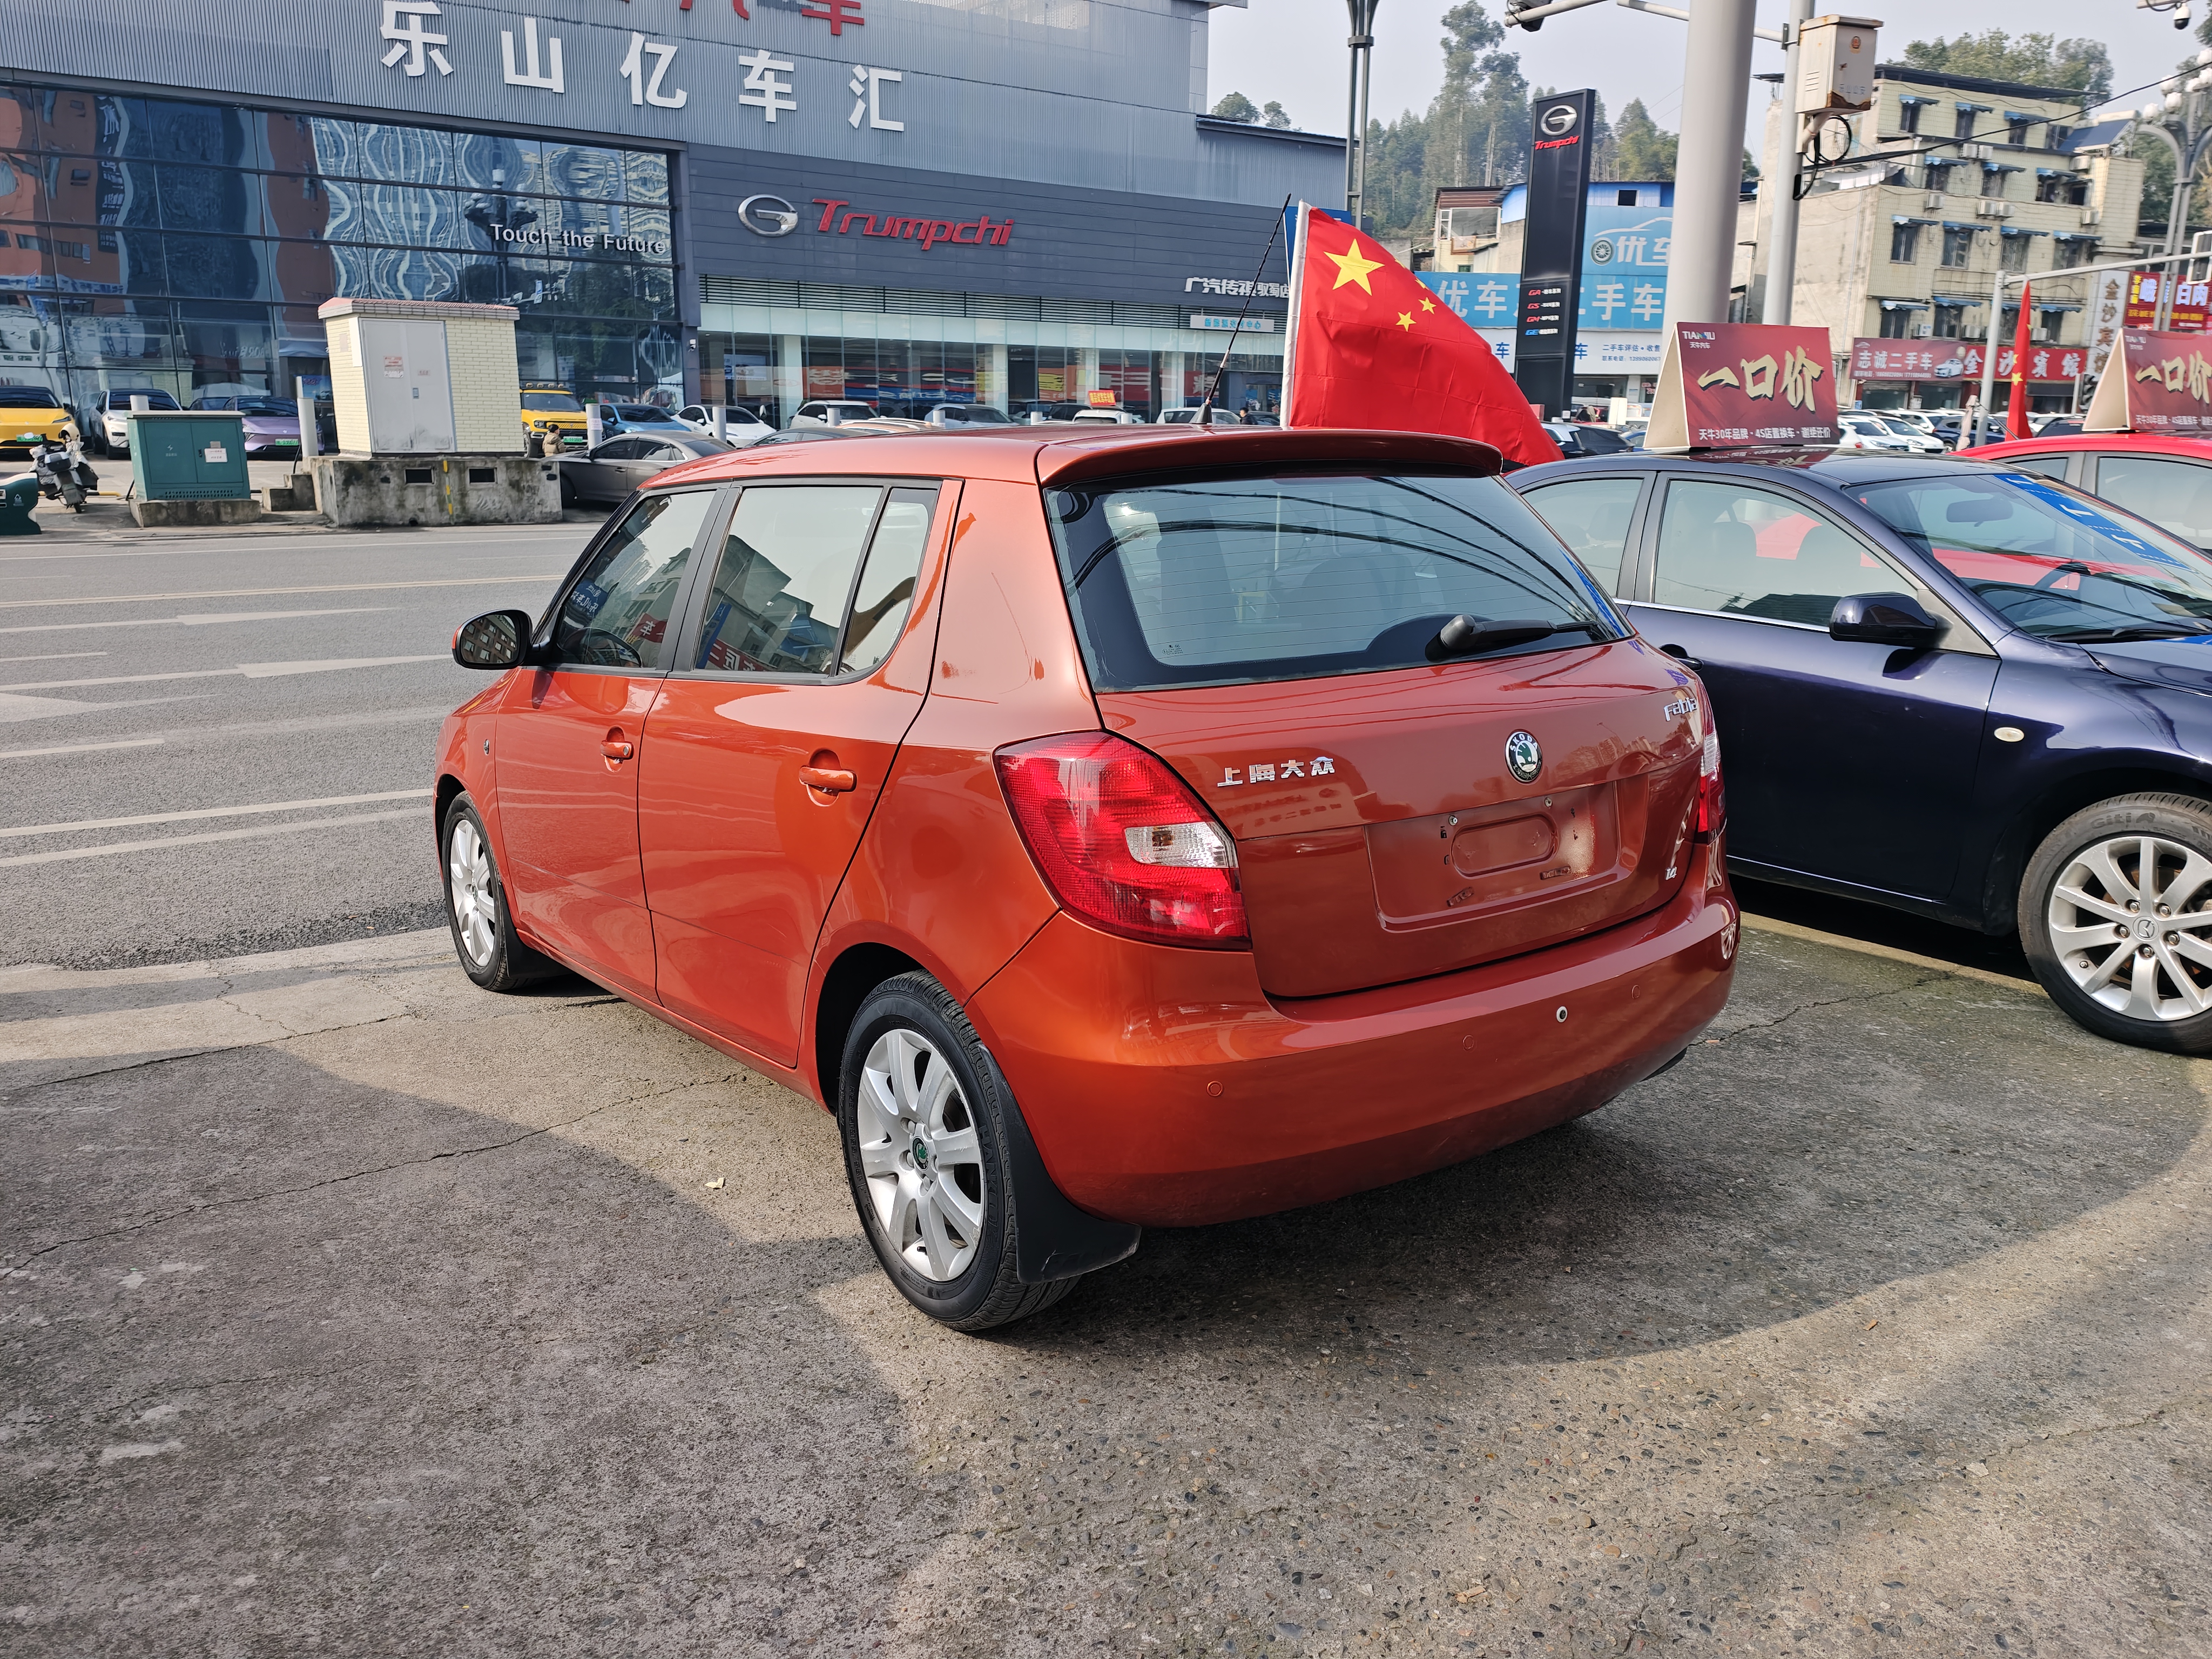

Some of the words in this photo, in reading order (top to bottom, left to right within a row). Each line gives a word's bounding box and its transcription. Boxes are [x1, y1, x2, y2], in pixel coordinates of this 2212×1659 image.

[380, 0, 905, 132] 乐山亿车汇
[1534, 136, 1580, 150] Trumpchi
[489, 223, 552, 244] Touch
[562, 230, 595, 248] the
[603, 233, 666, 254] Future
[812, 198, 1014, 251] Trumpchi
[1495, 342, 1510, 359] 车
[1857, 349, 1933, 370] 志诚二手车
[1696, 345, 1825, 413] 一口价
[2135, 350, 2212, 404] 一口价
[1664, 697, 1697, 721] Fabia
[1217, 756, 1336, 787] 上海大众
